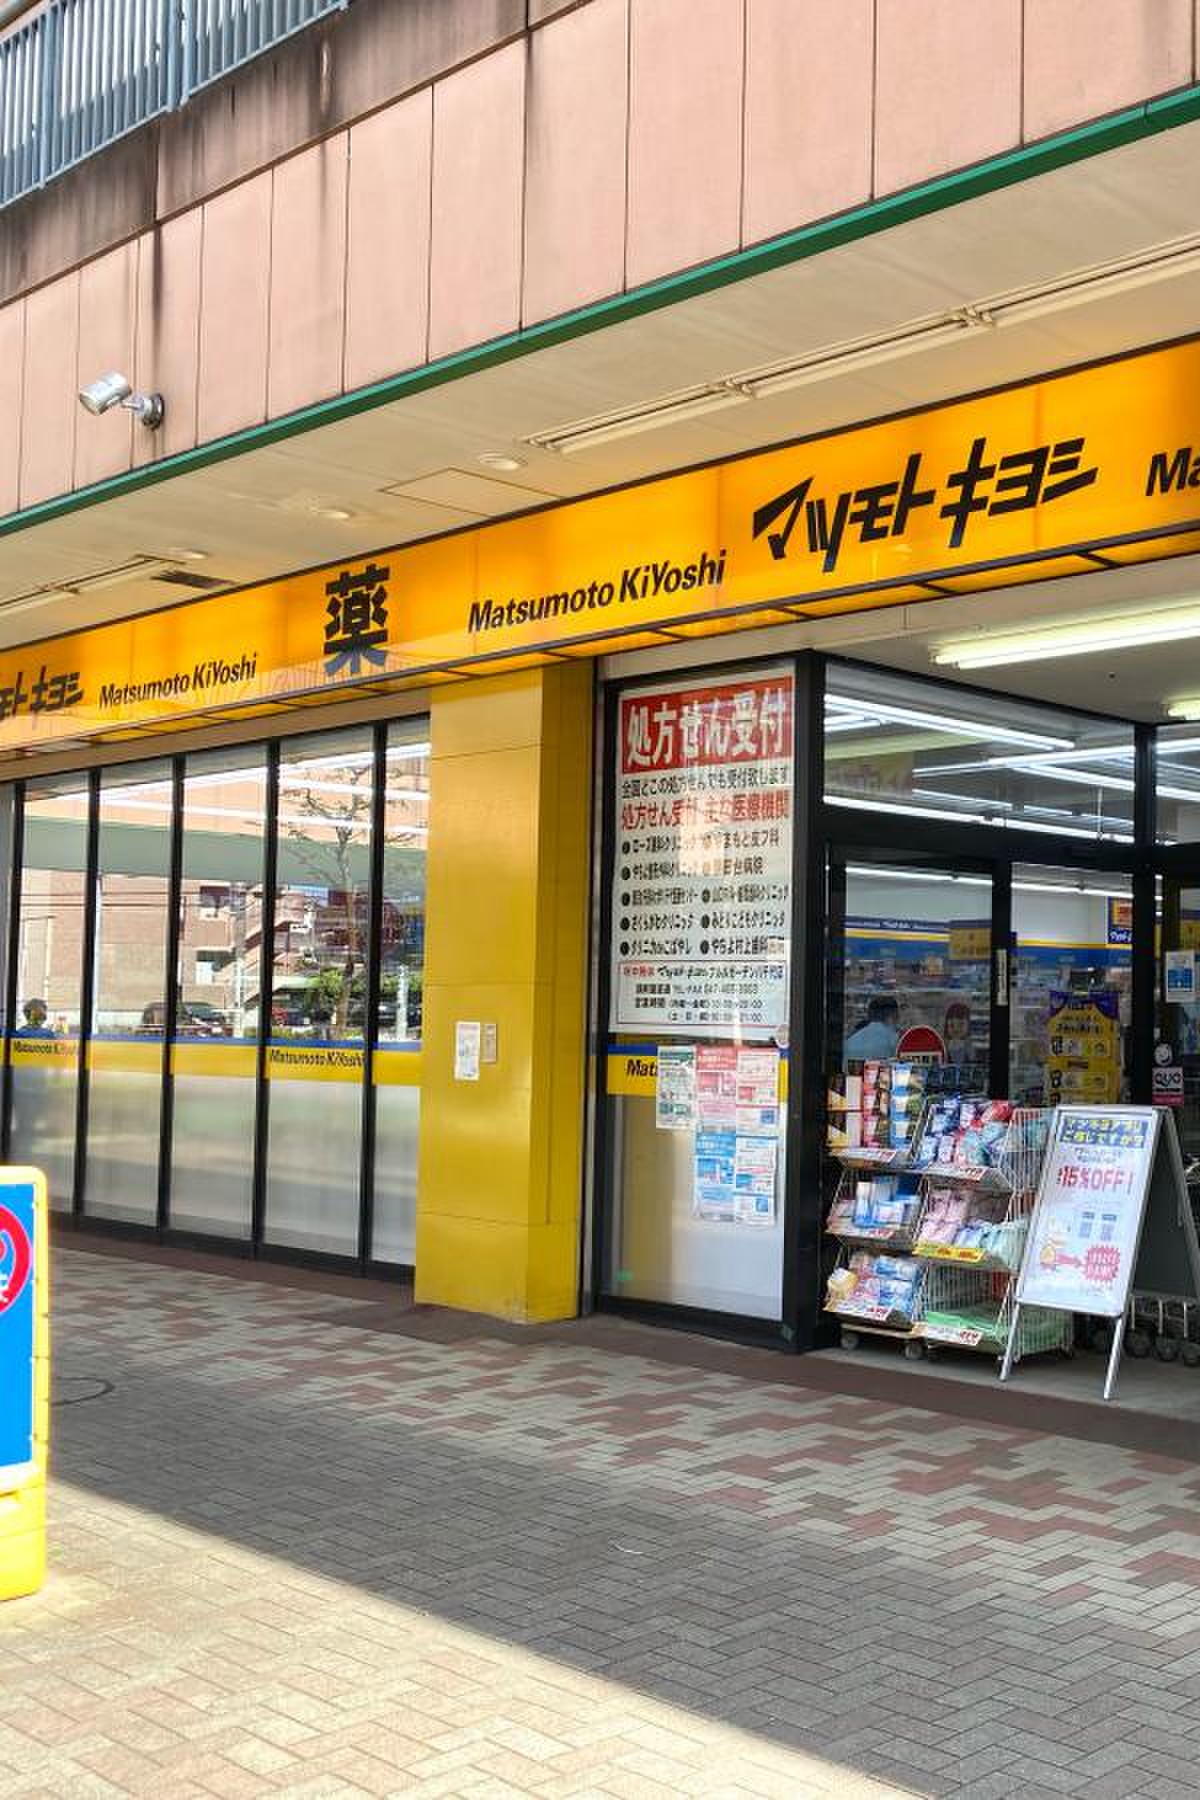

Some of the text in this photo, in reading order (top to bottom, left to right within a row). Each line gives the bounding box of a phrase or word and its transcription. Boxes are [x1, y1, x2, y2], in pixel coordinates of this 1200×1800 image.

[753, 438, 1098, 572] マツモトキヨシ
[324, 563, 389, 673] 薬
[468, 549, 725, 632] Matsumoto KiYoshi
[100, 652, 257, 709] Matsumoto KiYoshi
[628, 688, 786, 767] 処方せん受付
